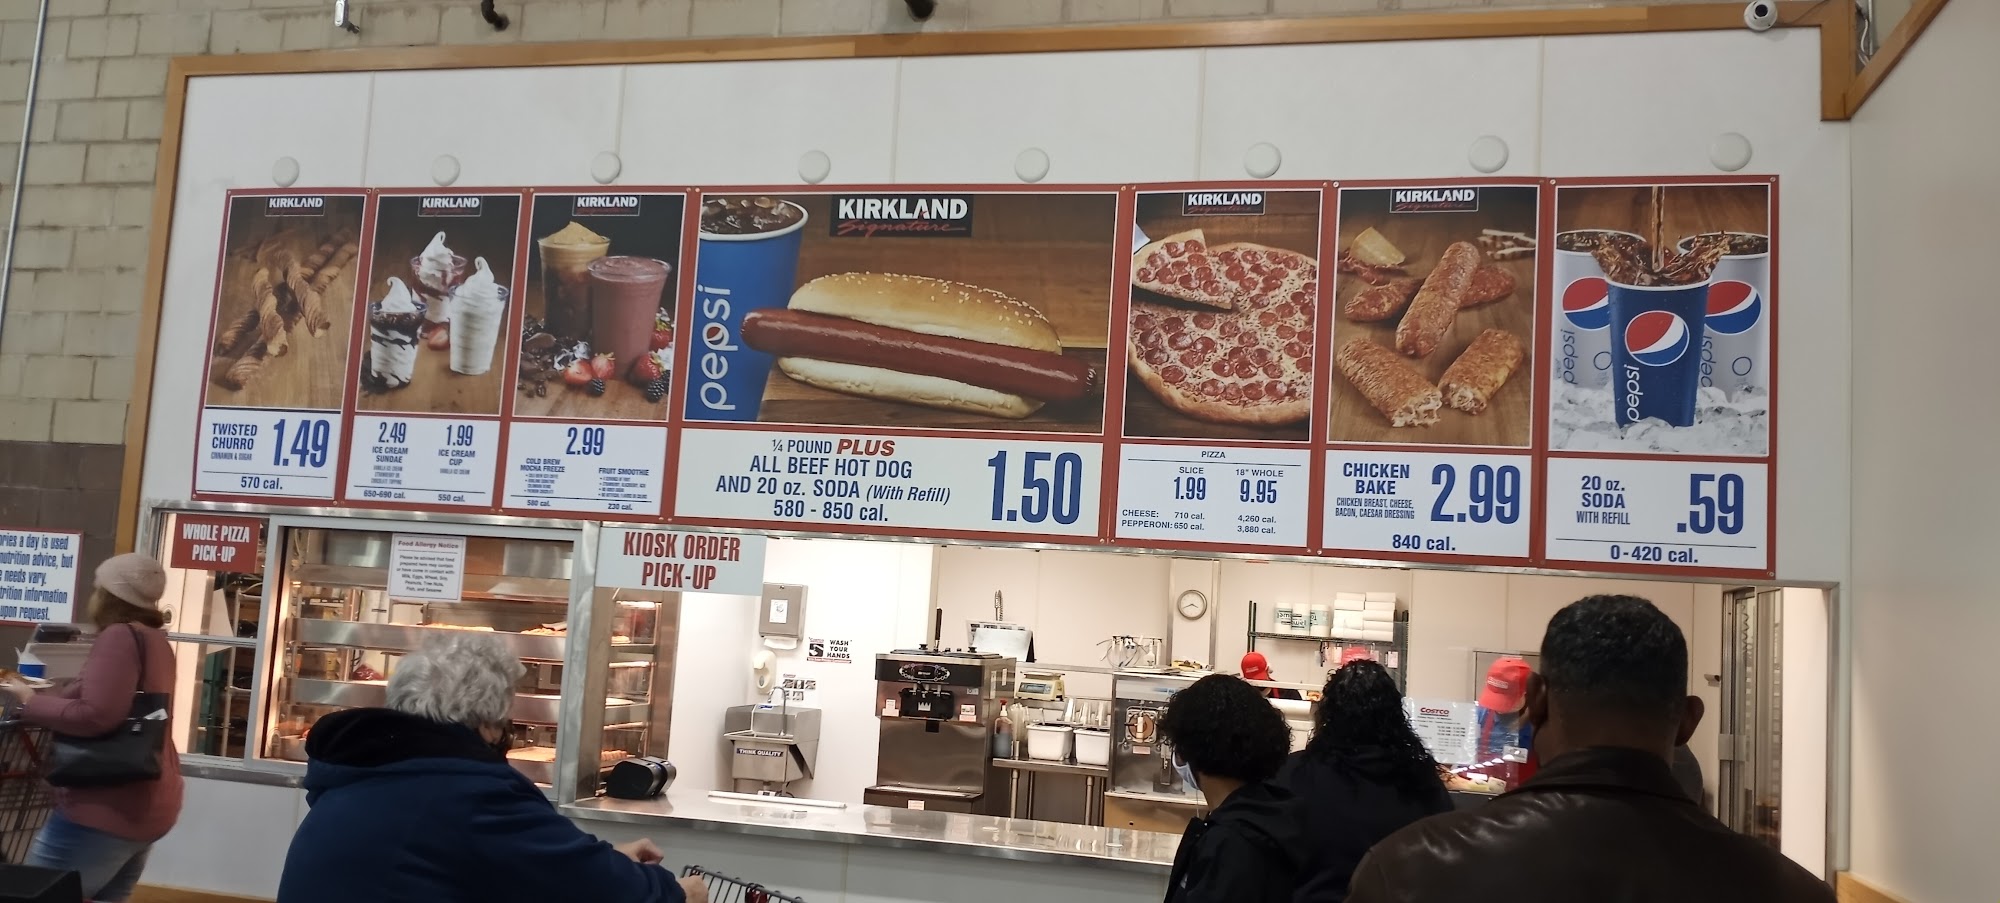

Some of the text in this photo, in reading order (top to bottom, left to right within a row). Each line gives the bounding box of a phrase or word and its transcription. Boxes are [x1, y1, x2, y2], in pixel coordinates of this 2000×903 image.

[269, 197, 323, 208] KIRKLAND
[422, 197, 480, 208] KIRKLAND
[577, 196, 638, 208] KIRKLAND
[1188, 193, 1262, 206] KIRKLAND
[1395, 189, 1475, 203] KIRKLAND
[838, 198, 968, 220] KIRKLAND
[837, 219, 967, 238] Signature
[697, 284, 739, 411] pepsi
[1560, 329, 1579, 385] pepsi
[1623, 364, 1644, 423] pepsi
[212, 423, 258, 436] TWISTED
[378, 422, 407, 444] 2.49
[446, 425, 474, 447] 1.99
[211, 436, 254, 450] CHURRO
[273, 419, 330, 468] 1.49
[566, 427, 605, 456] 2.99
[787, 440, 832, 454] POUND
[836, 439, 896, 456] PLUS
[372, 446, 408, 455] ICE CREAM
[438, 449, 476, 458] ICE CREAM
[1201, 451, 1226, 459] PIZZA
[376, 455, 403, 463] SUNDAE
[449, 458, 463, 466] CUP
[749, 455, 912, 478] ALL BEEF HOT DOG
[520, 464, 565, 473] MOCHA FREEZE
[599, 467, 650, 476] FRUIT SMOOTHIE
[1179, 466, 1204, 475] SLICE
[1251, 469, 1284, 478] WHOLE
[1343, 462, 1410, 479] CHICKEN
[240, 476, 283, 489] 570 cal.
[716, 475, 951, 506] AND 20 oz. SODA (With Refill)
[988, 450, 1082, 525] 1.50
[1173, 476, 1206, 501] 1.99
[1355, 480, 1396, 495] BAKE
[1581, 475, 1625, 491] 20 oz.
[363, 489, 406, 499] 650-690 cal.
[438, 493, 451, 502] 550
[1239, 479, 1277, 504] 9.95
[1430, 463, 1521, 524] 2.99
[1336, 497, 1362, 507] CHICKEN
[1390, 499, 1414, 509] CHEESE,
[1581, 493, 1625, 509] SODA
[1677, 473, 1744, 535] .59
[773, 499, 805, 518] 580
[822, 501, 853, 520] 850
[859, 503, 889, 522] cal.
[1122, 509, 1276, 524] CHEESE: 710 cal. 4,260 cal.
[1335, 508, 1415, 520] BACON, CAESAR DRESSING
[1576, 511, 1630, 525] WITH REFILL
[183, 523, 250, 543] WHOLE PIZZA
[1121, 520, 1276, 535] PEPPERONI: 650 cal. 3,880 cal.
[19, 536, 24, 547] a
[26, 534, 39, 551] day
[41, 534, 48, 549] is
[50, 536, 69, 550] used
[415, 541, 437, 549] Allergy
[623, 531, 741, 561] KIOSK ORDER
[1392, 534, 1456, 551] 840 cal.
[32, 552, 58, 569] advice,
[61, 553, 73, 568] but
[191, 544, 236, 562] PICK-UP
[1668, 548, 1698, 563] cal.
[4, 568, 26, 583] needs
[28, 571, 47, 586] vary.
[641, 561, 716, 590] PICK-UP
[24, 587, 68, 604] information
[0, 605, 50, 621] upon request.
[1420, 707, 1450, 715] COSTCO
